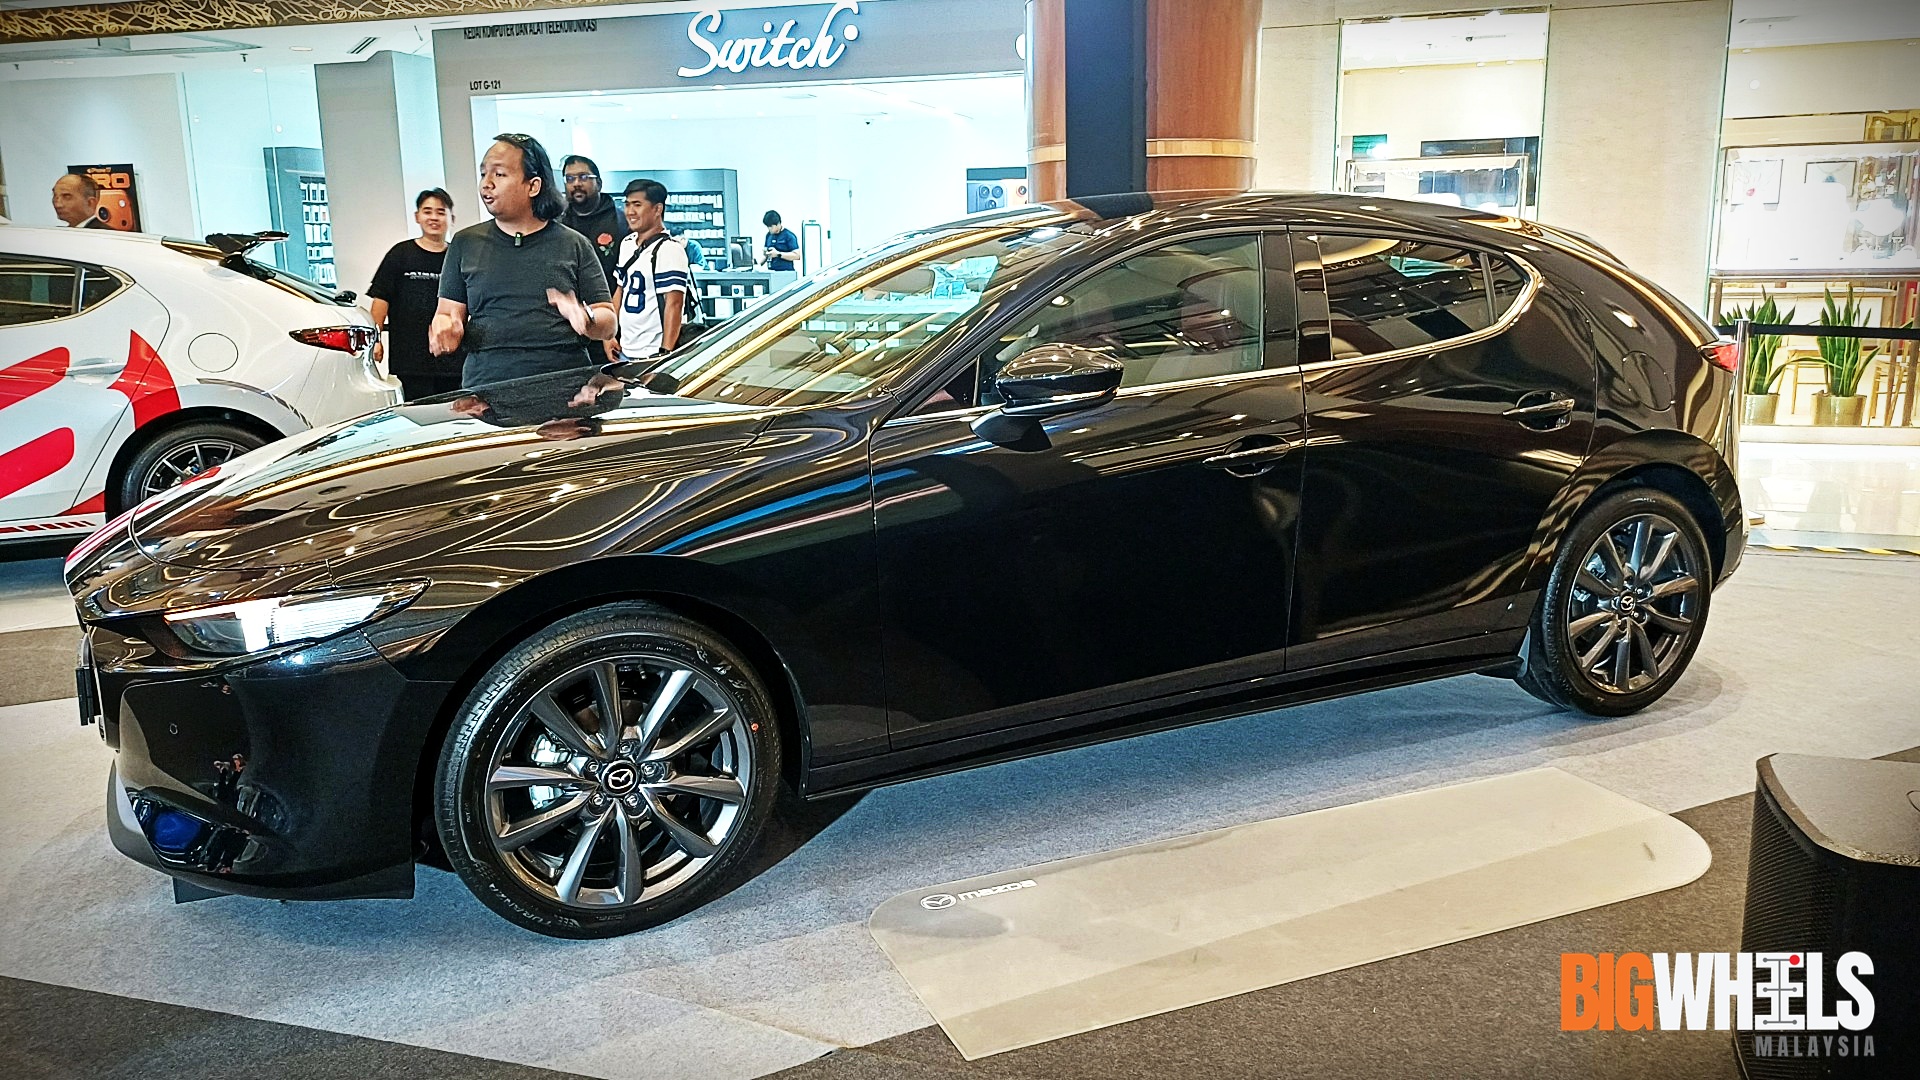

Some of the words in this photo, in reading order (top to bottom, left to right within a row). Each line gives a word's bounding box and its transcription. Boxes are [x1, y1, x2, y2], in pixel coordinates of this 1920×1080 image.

[677, 1, 859, 77] Switch
[470, 80, 482, 90] LOT
[483, 80, 501, 90] G-121
[957, 879, 1037, 900] mazda
